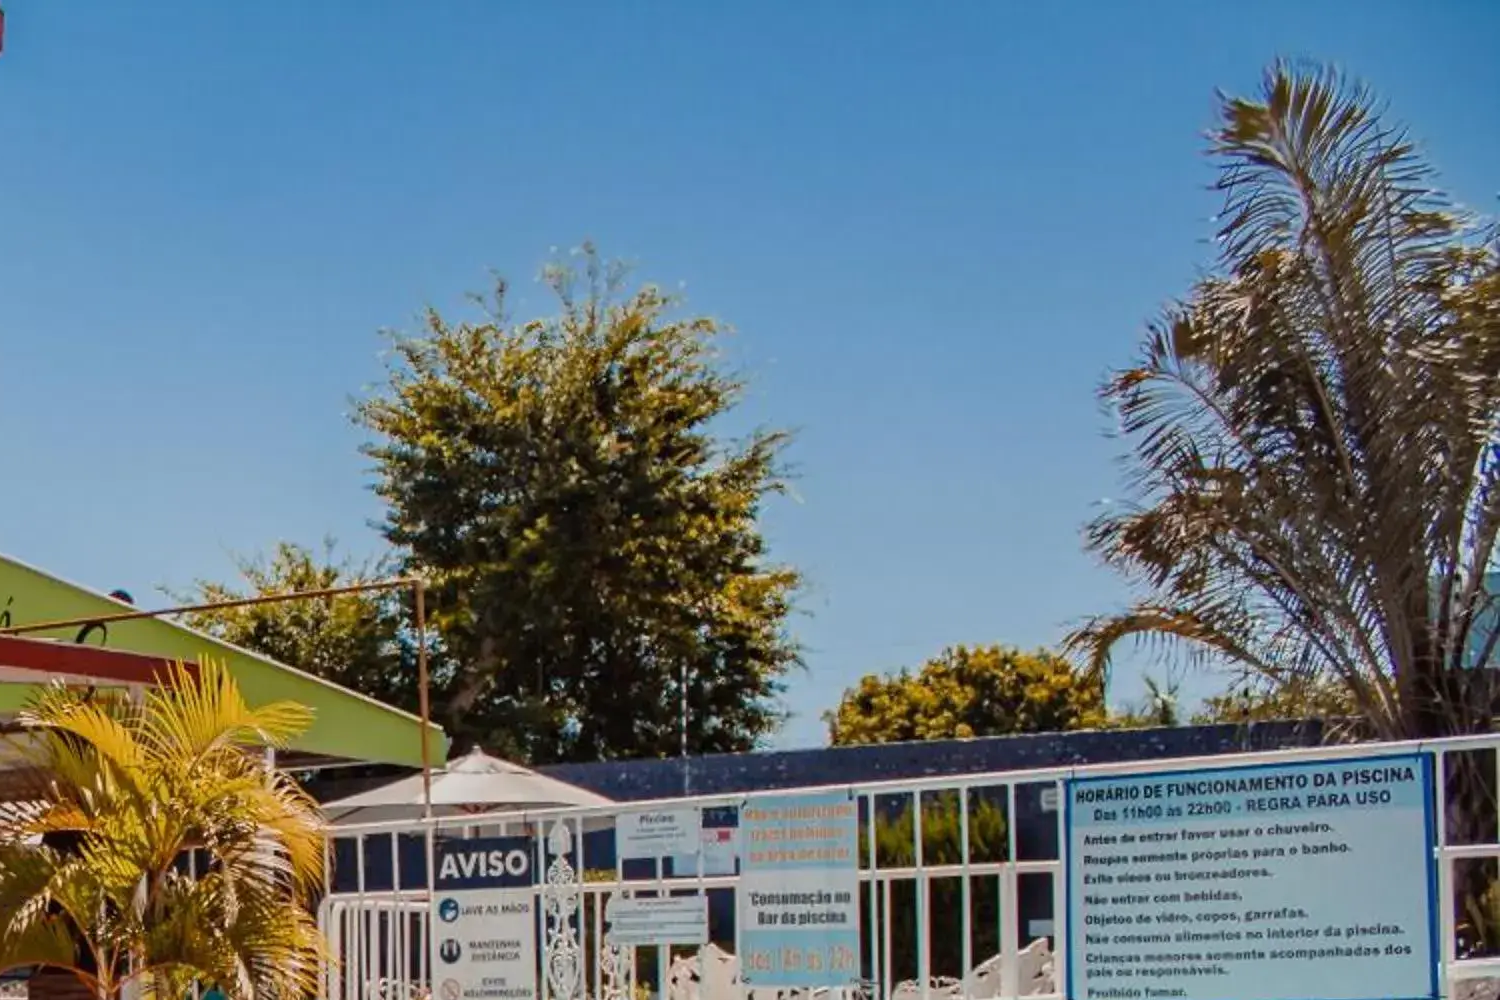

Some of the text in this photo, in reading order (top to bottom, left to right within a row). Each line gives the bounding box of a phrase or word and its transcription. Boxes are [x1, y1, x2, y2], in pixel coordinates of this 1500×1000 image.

[1076, 767, 1415, 804] HORÁRIO DE FUNCIONAMENTO DA PISCINA
[1093, 808, 1117, 821] Das
[1187, 801, 1231, 816] 22h00
[1247, 797, 1301, 812] REGRA
[1307, 793, 1350, 808] PARA
[1356, 790, 1391, 804] USO
[1084, 833, 1117, 846] Antes
[1120, 832, 1135, 843] de
[1139, 831, 1178, 843] entrar
[1181, 828, 1216, 840] favor
[1220, 829, 1249, 839] usar
[1255, 828, 1263, 837] o
[1084, 855, 1129, 866] Roupas
[1132, 852, 1187, 863] somente
[1253, 847, 1285, 859] para
[1289, 846, 1298, 855] o
[439, 850, 529, 880] AVISO
[1155, 872, 1171, 882] ou
[834, 891, 851, 904] no
[1084, 893, 1108, 905] Não
[1111, 894, 1150, 905] entrar
[1153, 893, 1181, 903] com
[461, 906, 483, 916] LAVE
[486, 905, 498, 915] AS
[757, 911, 778, 925] Bar
[798, 910, 847, 926] piscina
[1085, 914, 1133, 927] Objetos
[1136, 913, 1152, 924] de
[1113, 934, 1171, 944] consuma
[1175, 929, 1241, 941] alimentos
[1246, 931, 1263, 940] no
[1267, 927, 1319, 939] interior
[1323, 925, 1341, 937] da
[469, 940, 522, 950] MANTENHA
[1085, 943, 1413, 964] Crianças menores somente acompanhadas dos
[1086, 966, 1113, 979] pais
[1116, 967, 1132, 977] ou
[1087, 987, 1141, 998] Proibido
